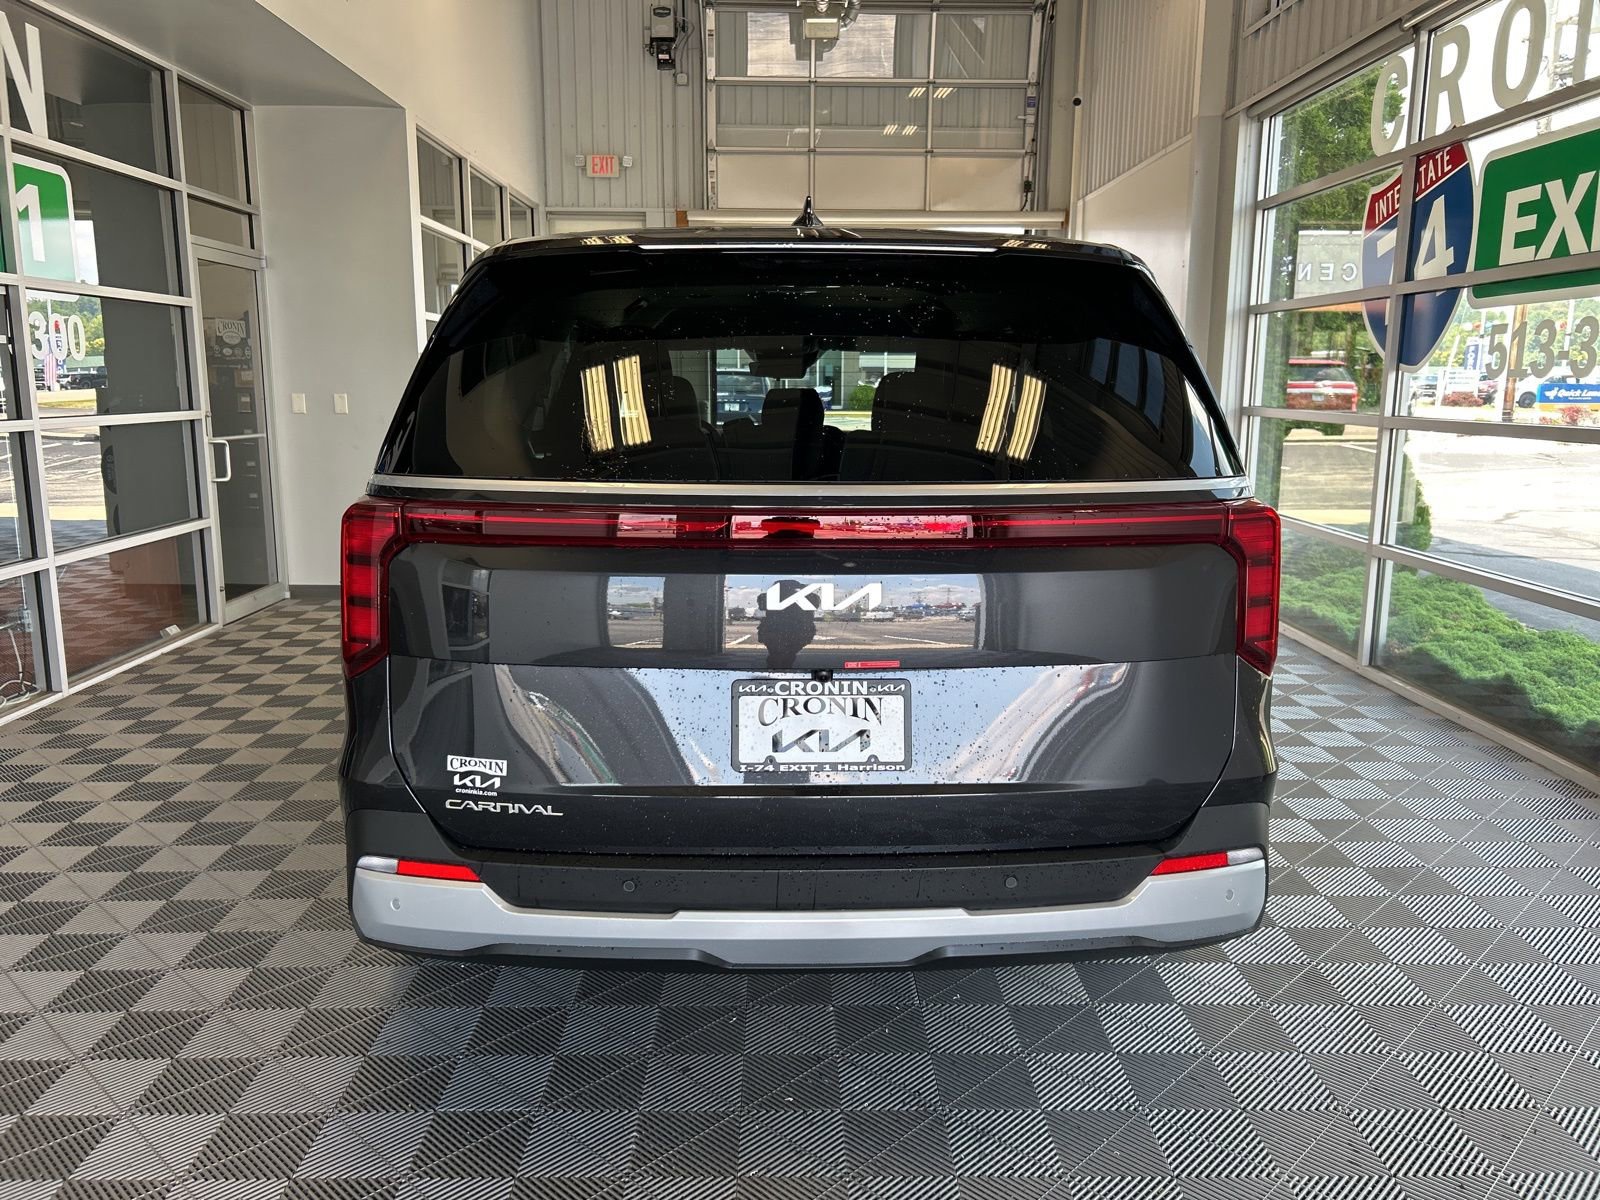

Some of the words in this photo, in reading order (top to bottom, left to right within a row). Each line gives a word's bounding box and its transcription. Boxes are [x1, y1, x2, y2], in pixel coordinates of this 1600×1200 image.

[591, 154, 615, 175] EXIT
[1375, 147, 1453, 225] INTETATE
[16, 184, 46, 263] 1
[1557, 388, 1582, 398] Quick
[766, 582, 883, 611] KIA
[738, 684, 768, 693] KIA
[774, 681, 869, 696] CRONIN
[877, 683, 906, 692] KIA
[757, 697, 883, 727] CRONIN
[771, 728, 871, 753] KIA
[449, 757, 504, 775] CRONIN
[740, 764, 775, 772] I-74
[779, 764, 818, 772] EXIT
[823, 764, 833, 772] 1
[837, 763, 906, 772] Harrison
[453, 773, 501, 790] KIA
[455, 787, 498, 797] croninkia.com
[445, 799, 564, 816] CARNIVAL
